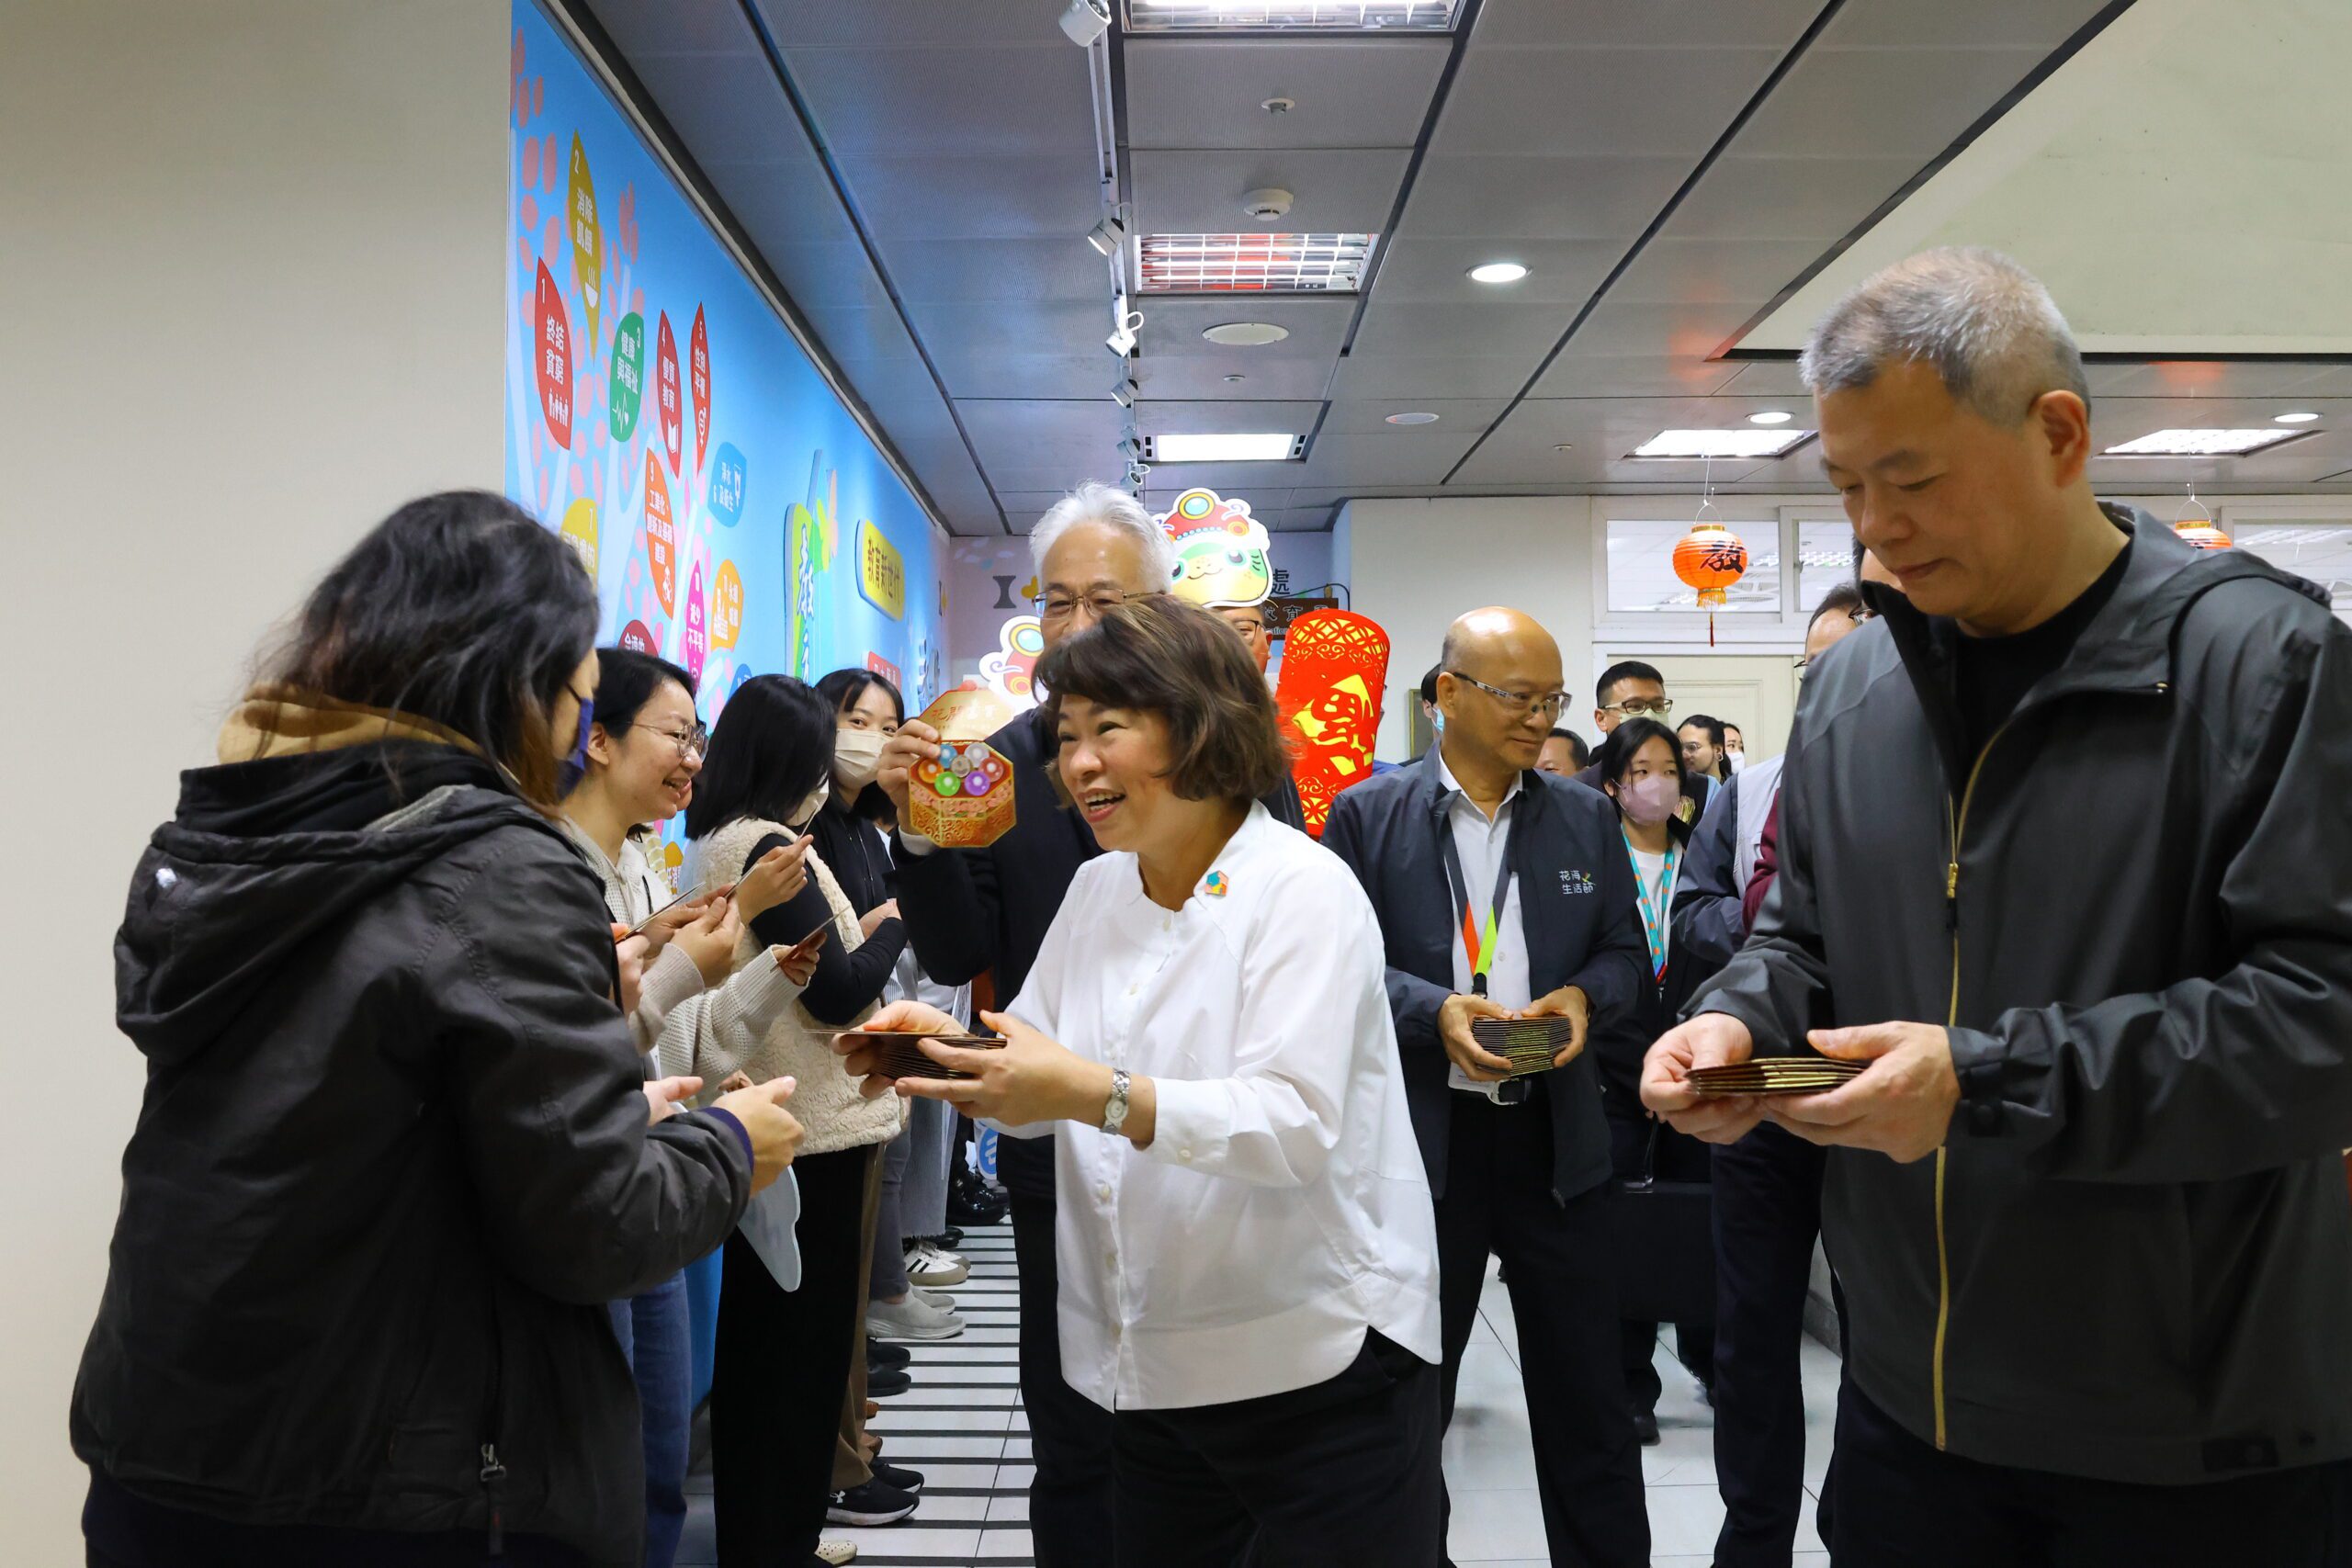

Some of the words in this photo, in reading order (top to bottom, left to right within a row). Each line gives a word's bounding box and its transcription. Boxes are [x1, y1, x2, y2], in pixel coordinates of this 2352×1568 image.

[574, 149, 579, 175] 2
[576, 186, 594, 224] 消除
[541, 277, 546, 304] 1
[546, 313, 565, 354] 終結
[637, 326, 641, 349] 3
[662, 326, 666, 348] 4
[699, 320, 704, 341] 5
[621, 330, 636, 363] 健康
[546, 347, 564, 386] 貧窮
[616, 355, 639, 395] 與福祉
[650, 461, 655, 482] 9
[687, 627, 704, 654] 不平等
[1558, 870, 1581, 882] 花海
